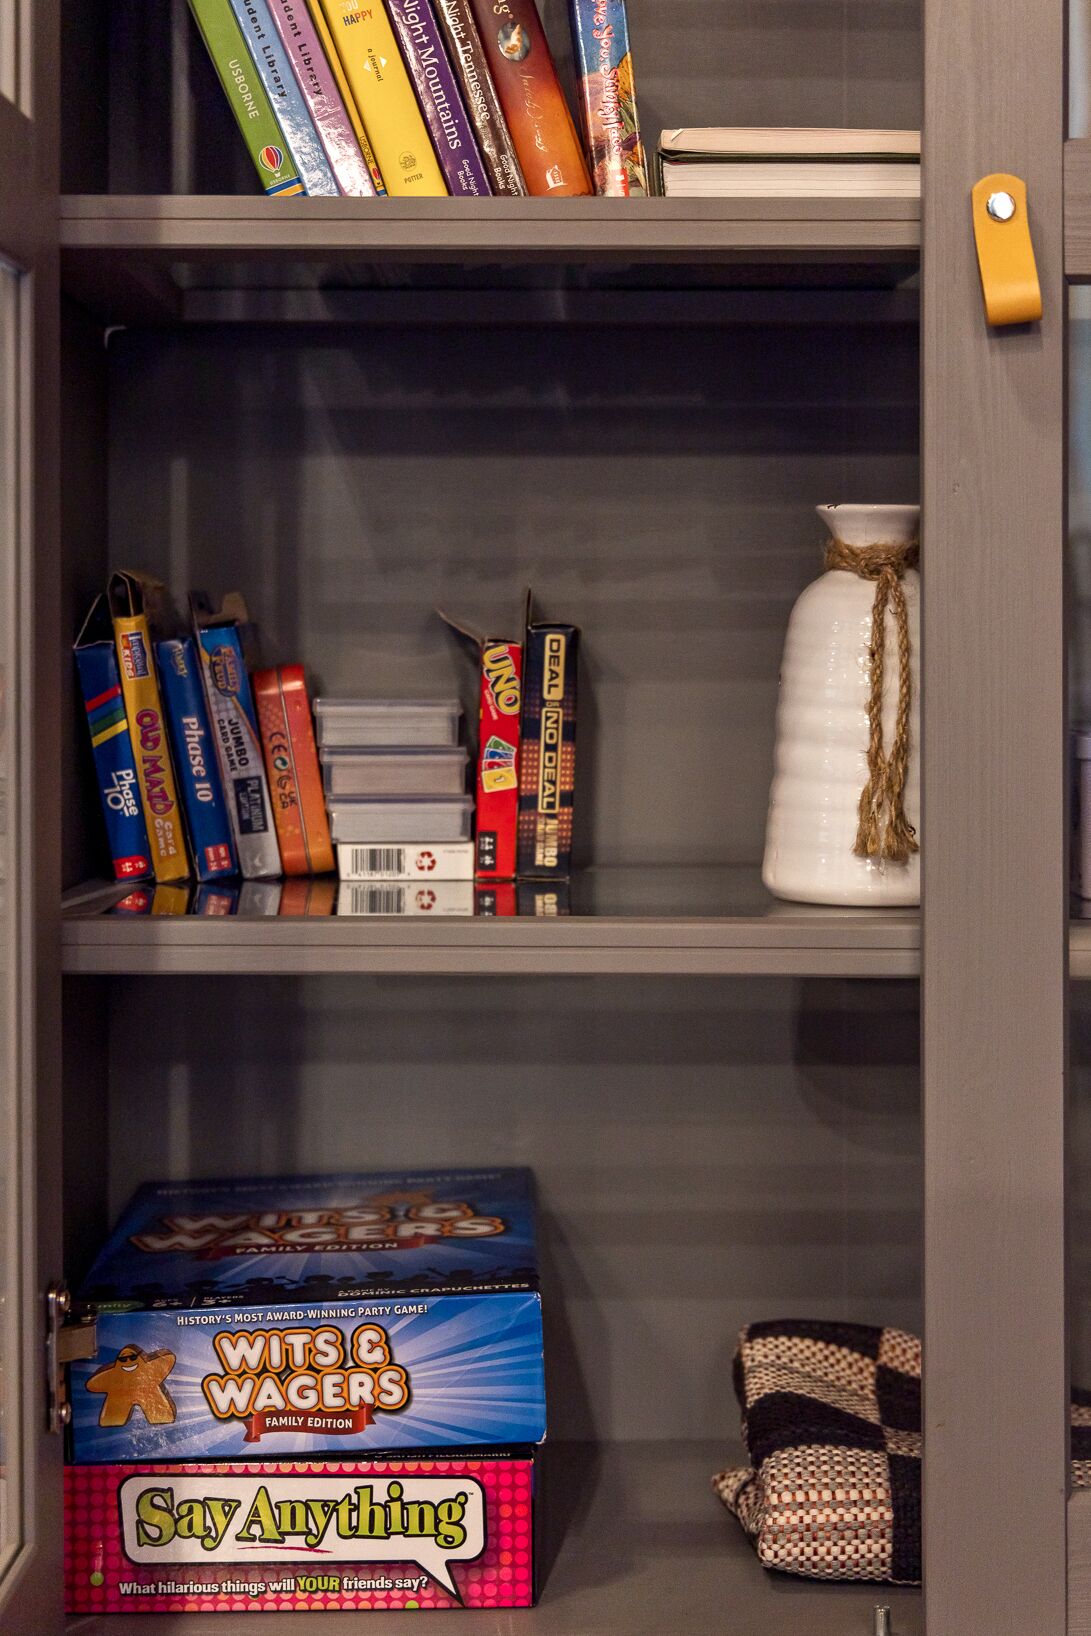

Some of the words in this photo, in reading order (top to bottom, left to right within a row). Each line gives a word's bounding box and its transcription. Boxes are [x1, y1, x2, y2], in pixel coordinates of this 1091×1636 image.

[343, 9, 373, 26] HAPPY
[593, 0, 607, 26] ove
[243, 0, 266, 40] udent
[262, 45, 288, 98] Library
[280, 0, 302, 37] udent
[298, 43, 323, 96] Library
[368, 54, 384, 82] journal
[403, 0, 428, 49] Night
[418, 45, 462, 150] Mountains
[459, 41, 491, 121] Tennessee
[228, 59, 260, 119] USBORNE
[404, 173, 424, 184] POTTER
[457, 170, 468, 190] Books
[462, 159, 474, 176] Good
[468, 177, 479, 196] Night
[494, 167, 506, 189] Books
[500, 154, 511, 174] Good
[507, 174, 518, 196] Night
[122, 649, 134, 677] KIDS
[212, 656, 226, 689] FEUD
[221, 647, 240, 692] FAMILY
[483, 645, 521, 715] UNO
[546, 637, 562, 695] DEAL
[135, 708, 160, 752] OLD
[217, 718, 231, 746] CARD
[227, 718, 250, 767] JUMBO
[545, 712, 560, 744] NO
[182, 717, 206, 777] Phase
[194, 782, 213, 802] 10
[223, 748, 237, 772] GAME
[104, 785, 125, 811] 10
[115, 768, 139, 817] Phase
[142, 755, 175, 816] MAID
[542, 754, 559, 811] DEAL
[246, 779, 265, 832] PLATINUM
[154, 818, 167, 857] Game
[164, 821, 177, 855] Card
[544, 818, 559, 868] JUMBO
[138, 1218, 500, 1249] WAGERS
[170, 1207, 385, 1231] WITS
[235, 1244, 307, 1254] FAMILY
[313, 1242, 398, 1251] EDITION
[338, 1289, 406, 1297] DOMINIC
[410, 1282, 530, 1293] CRAPUCHETTES
[177, 1314, 232, 1326] HISTORY'S
[234, 1312, 264, 1323] MOST
[266, 1308, 356, 1322] AWARD-WINNING
[357, 1306, 391, 1317] PARTY
[394, 1304, 428, 1315] GAME!
[217, 1329, 342, 1373] WITS
[354, 1327, 388, 1367] &
[204, 1367, 407, 1416] WAGERS
[265, 1416, 304, 1428] FAMILY
[307, 1417, 353, 1429] EDITION
[136, 1487, 242, 1551] Say
[235, 1480, 469, 1549] Anything
[119, 1582, 156, 1595] What
[158, 1580, 219, 1594] hilarious
[221, 1579, 266, 1597] things
[268, 1578, 295, 1592] will
[297, 1576, 340, 1592] YOUR
[343, 1576, 393, 1589] friends
[395, 1575, 428, 1592] say?
